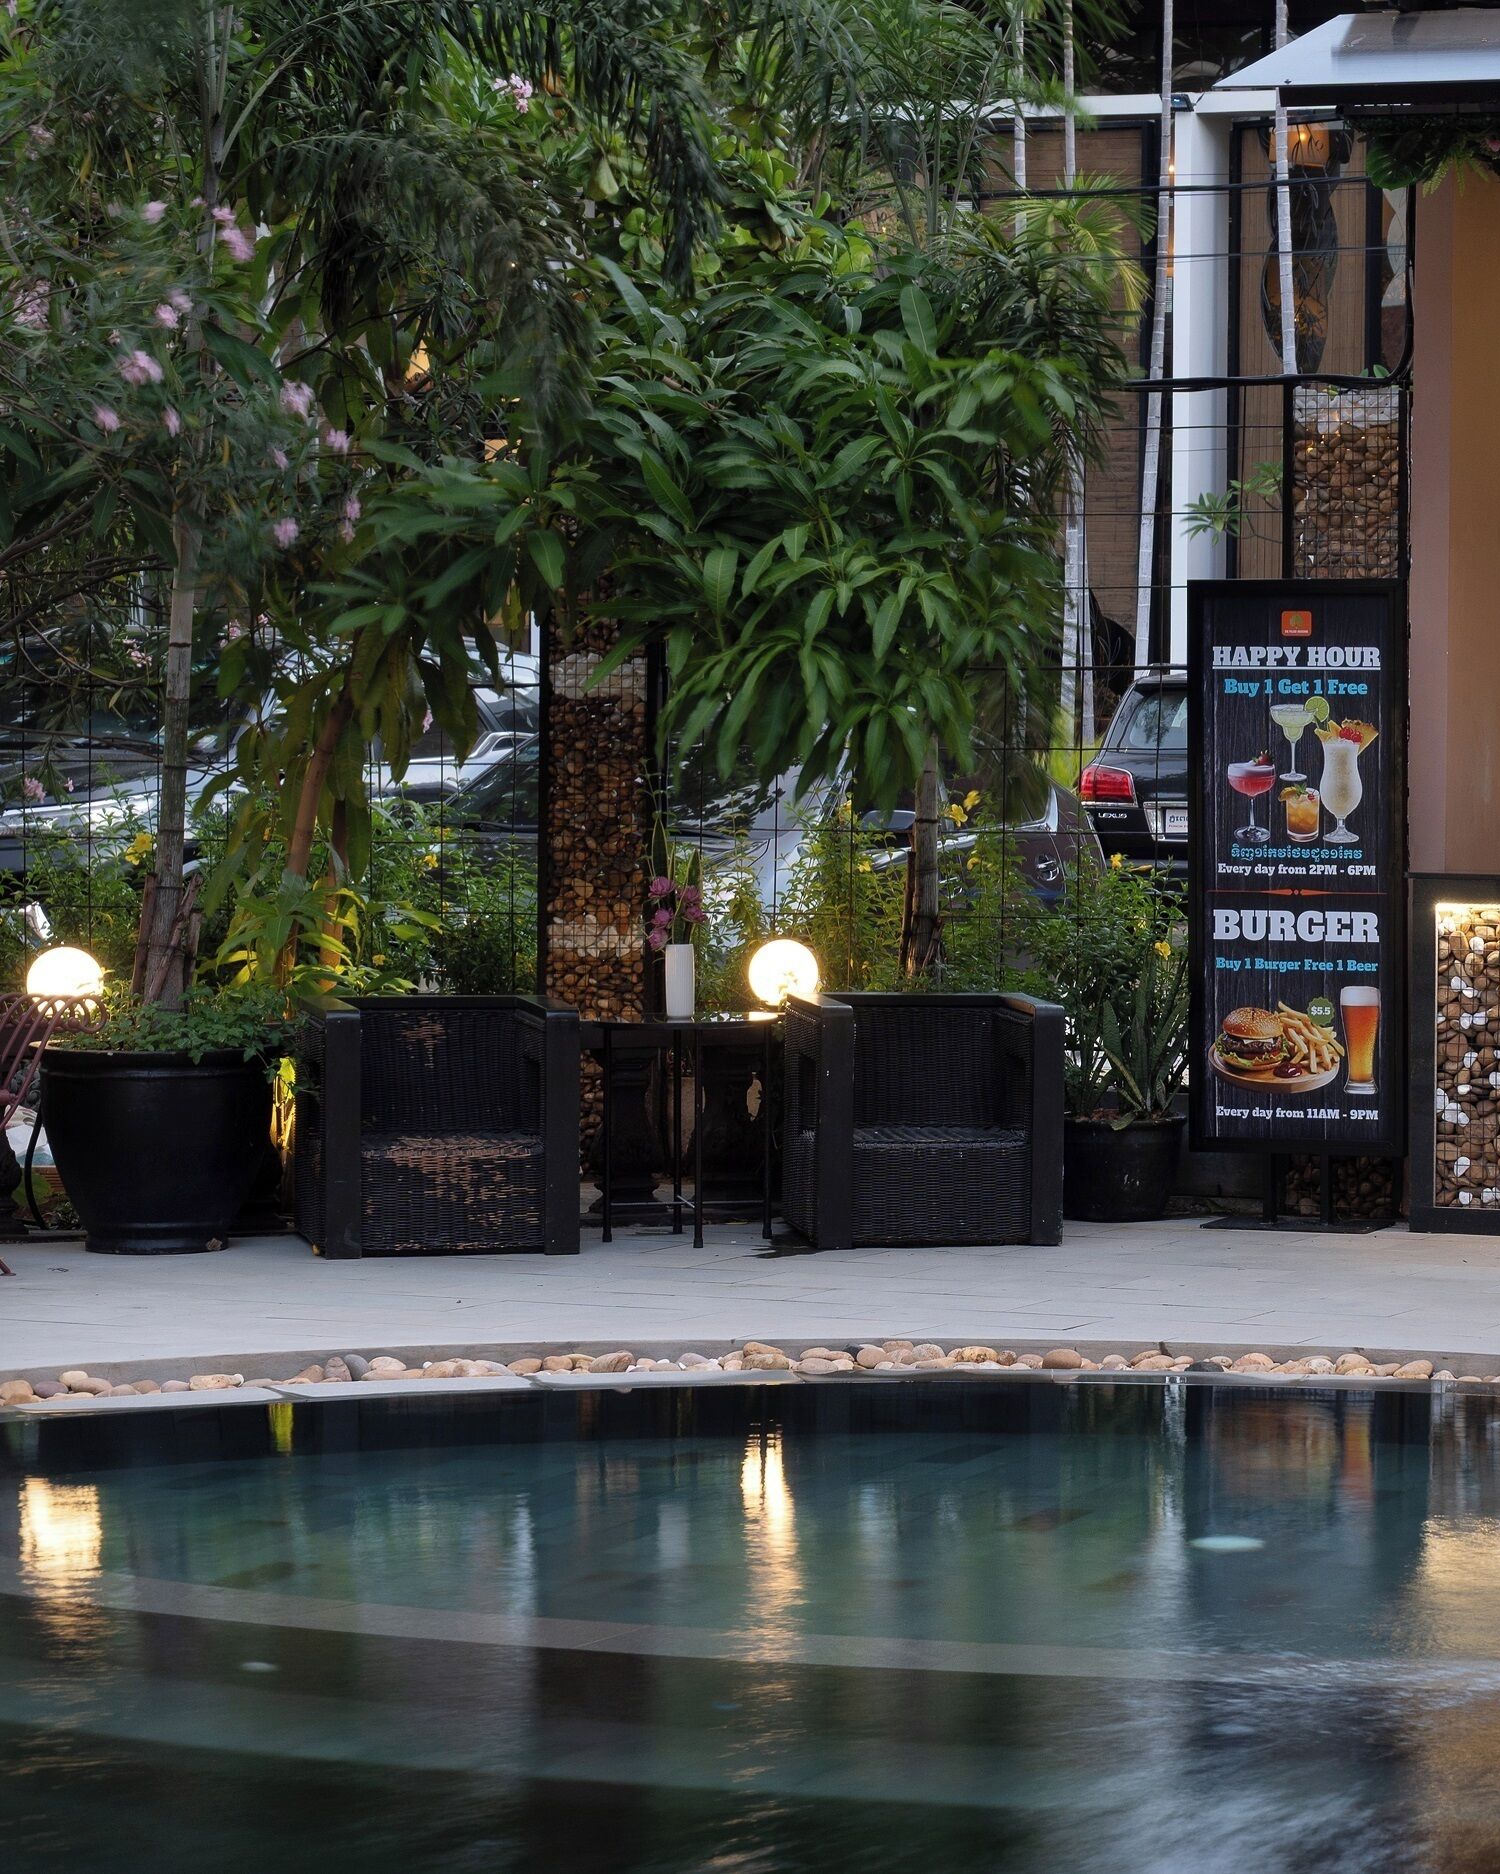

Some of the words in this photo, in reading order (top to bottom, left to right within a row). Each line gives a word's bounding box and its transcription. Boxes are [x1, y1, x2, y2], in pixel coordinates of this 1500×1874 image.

[1212, 646, 1301, 666] HAPPY
[1307, 646, 1381, 667] HOUR
[1224, 678, 1260, 698] Buy
[1264, 678, 1273, 694] 1
[1278, 678, 1309, 694] Get
[1313, 679, 1323, 695] 1
[1327, 679, 1368, 695] Free
[1217, 863, 1252, 876] Every
[1254, 863, 1276, 876] day
[1278, 863, 1306, 875] from
[1309, 864, 1338, 875] 2PM
[1347, 865, 1376, 876] 6PM
[1213, 908, 1380, 943] BURGER
[1215, 957, 1241, 971] Buy
[1244, 957, 1252, 969] 1
[1255, 957, 1301, 973] Burger
[1304, 958, 1334, 971] Free
[1336, 959, 1344, 971] 1
[1347, 959, 1379, 972] Beer
[1310, 1005, 1331, 1016] $5.5
[1216, 1105, 1250, 1119] Every
[1252, 1106, 1273, 1120] day
[1276, 1107, 1304, 1118] from
[1307, 1108, 1340, 1119] 11AM
[1350, 1109, 1379, 1120] 9PM
